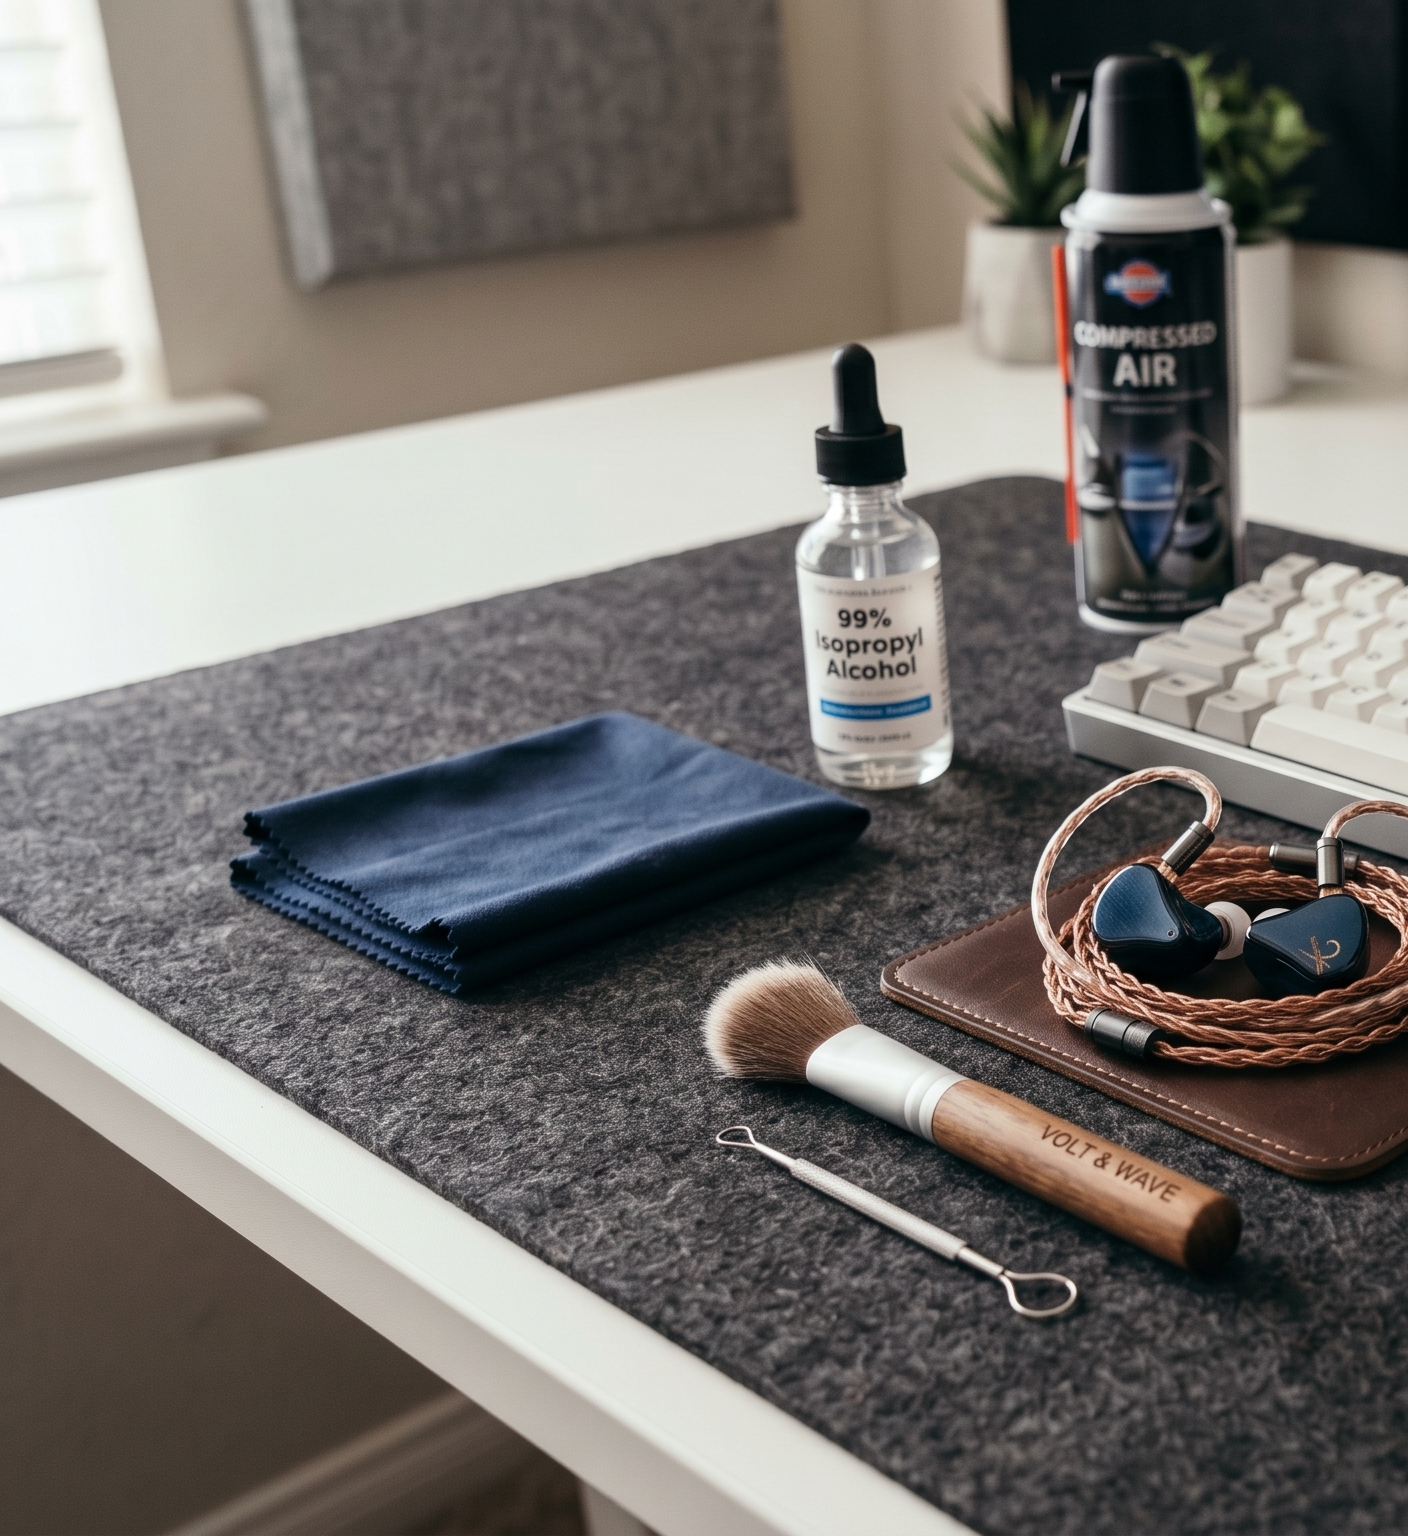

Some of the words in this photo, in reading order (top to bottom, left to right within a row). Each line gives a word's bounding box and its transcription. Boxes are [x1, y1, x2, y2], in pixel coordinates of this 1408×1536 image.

[1074, 320, 1218, 349] COMPRESSED
[1113, 352, 1178, 388] AIR
[838, 607, 892, 629] 99%
[816, 627, 924, 658] Isopropyl
[826, 655, 917, 681] Alcohol
[1040, 1124, 1097, 1159] VOLT
[1093, 1151, 1110, 1170] &
[1115, 1160, 1182, 1203] WAVE
